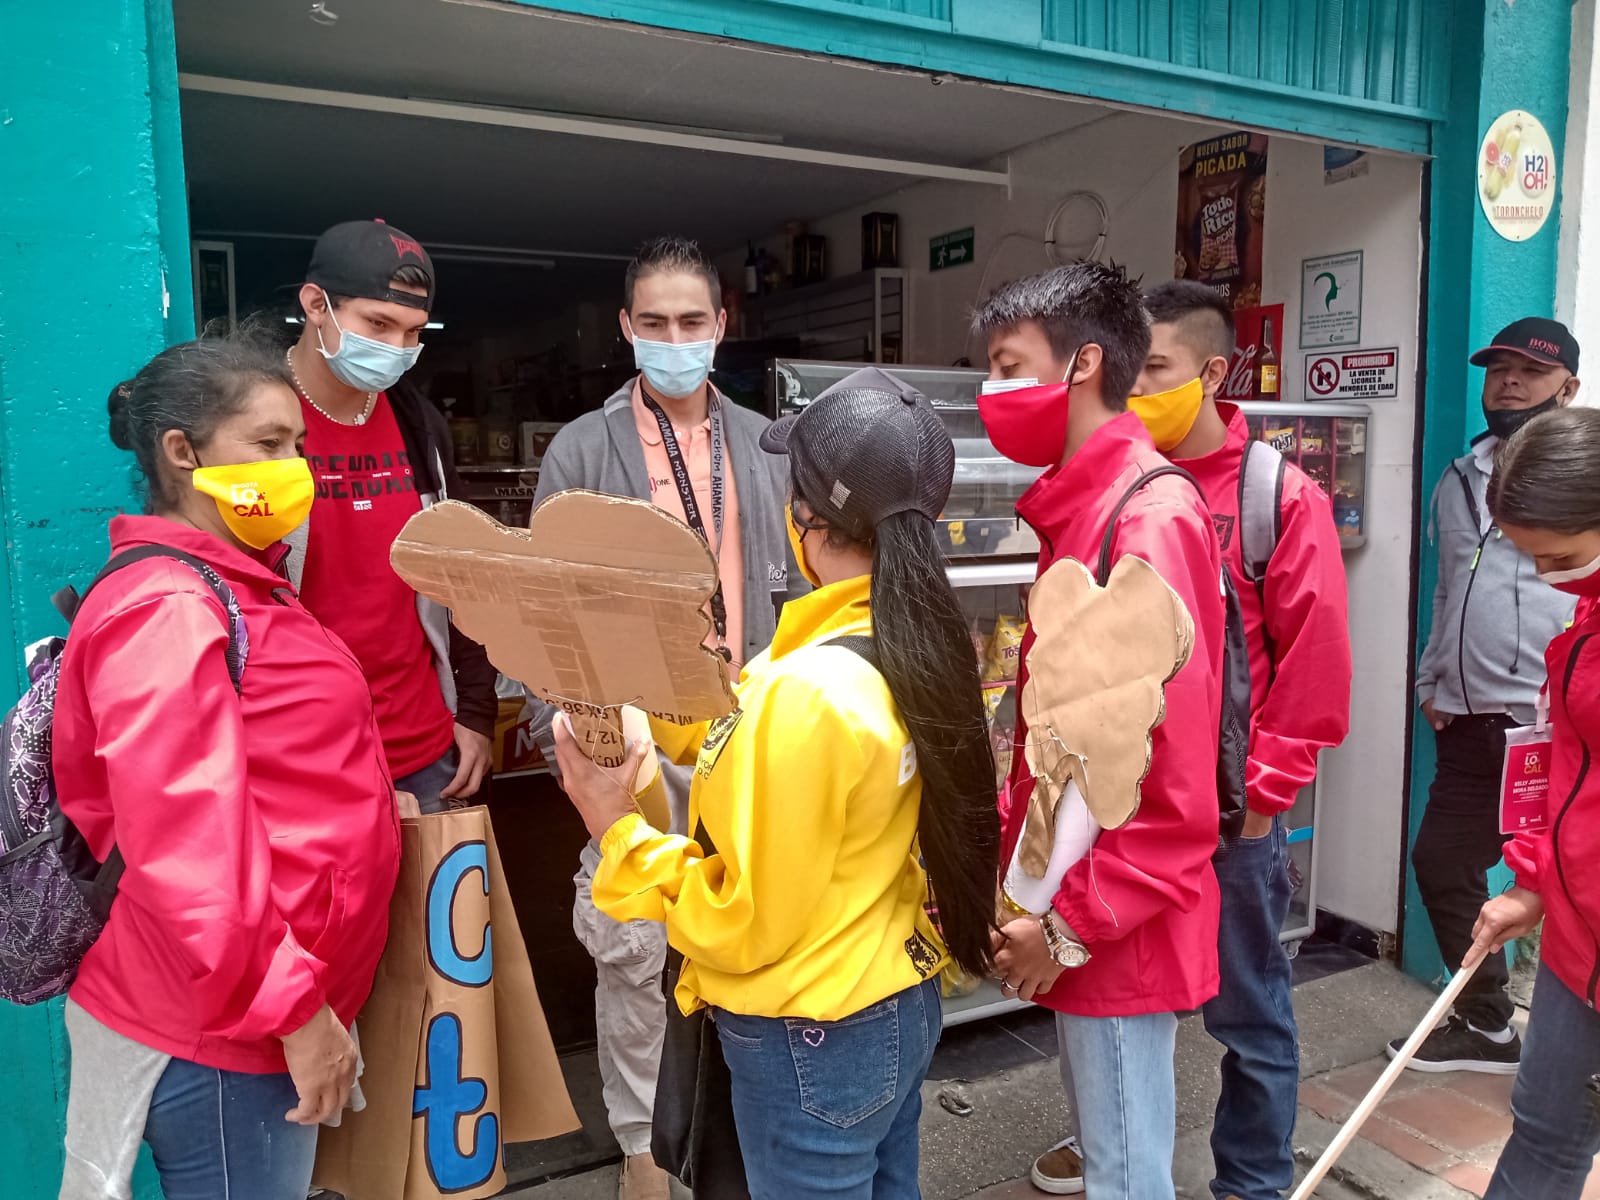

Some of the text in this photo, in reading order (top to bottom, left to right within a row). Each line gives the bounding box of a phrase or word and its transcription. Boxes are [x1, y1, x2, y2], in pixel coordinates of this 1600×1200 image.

[1196, 134, 1248, 157] NUEVO SABOR
[1195, 151, 1247, 178] PICADA
[1524, 155, 1544, 172] H2
[1202, 196, 1233, 219] Todo
[1495, 205, 1544, 218] TORONCHELO
[1204, 210, 1236, 235] Rico
[1529, 338, 1560, 354] BOSS
[1347, 355, 1388, 368] PROHIBIDO
[1358, 369, 1377, 377] VENTA
[1339, 384, 1367, 392] MENORES
[1377, 383, 1394, 391] EDAD
[1351, 377, 1376, 385] LICORES
[659, 416, 679, 458] YAMAHA
[232, 487, 257, 504] LO
[233, 502, 274, 517] CAL
[1524, 755, 1538, 766] LO
[1523, 763, 1543, 775] CAL
